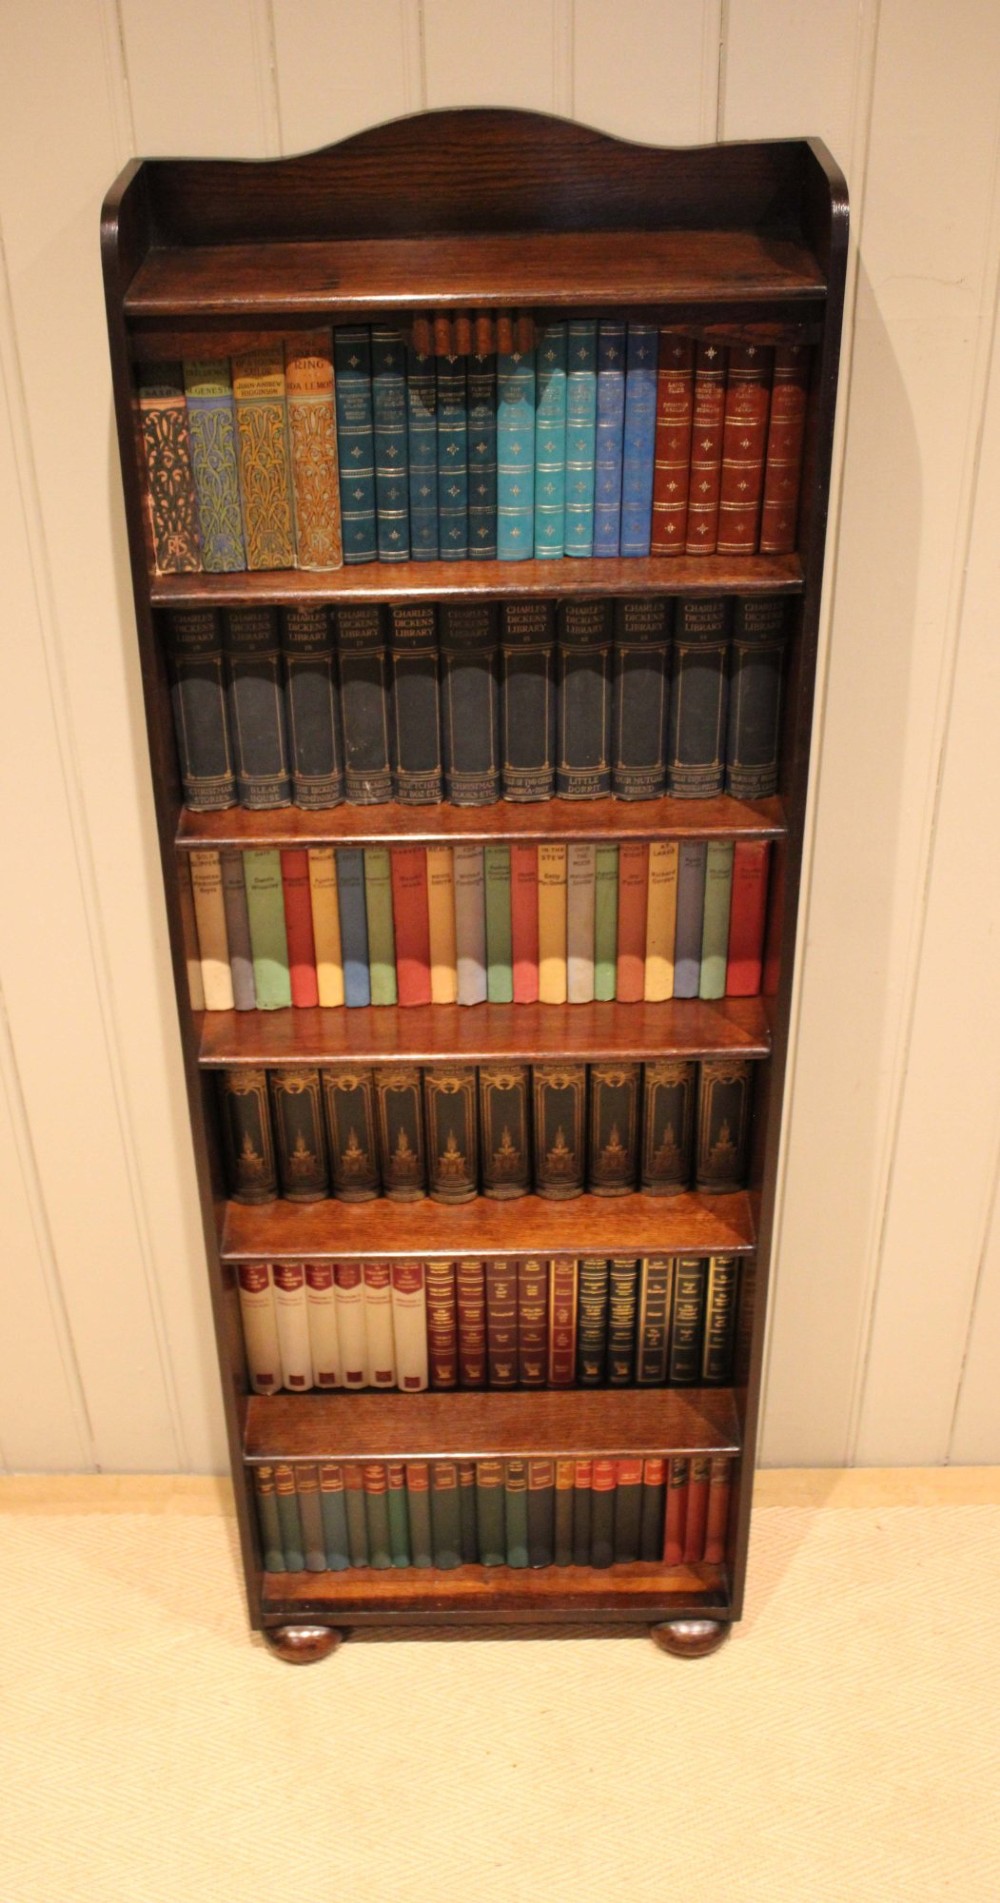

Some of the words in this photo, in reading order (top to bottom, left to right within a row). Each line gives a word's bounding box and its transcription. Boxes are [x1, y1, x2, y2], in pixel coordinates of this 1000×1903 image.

[295, 359, 324, 370] RING
[506, 605, 547, 615] CHARLES
[565, 605, 605, 614] CHARLES
[624, 603, 665, 612] CHARLES
[684, 603, 724, 612] CHARLES
[287, 613, 327, 622] CHARLES
[338, 610, 379, 619] CHARLES
[393, 608, 434, 618] CHARLES
[625, 612, 665, 622] DICKENS
[684, 612, 724, 622] DICKENS
[339, 619, 380, 628] DICKENS
[394, 618, 434, 627] DICKENS
[507, 614, 547, 624] DICKENS
[566, 614, 605, 624] DICKENS
[288, 622, 328, 632] DICKENS
[395, 627, 434, 637] LIBRARY
[507, 623, 546, 633] LIBRARY
[566, 624, 604, 634] LIBRARY
[625, 622, 663, 632] LIBRARY
[684, 622, 722, 632] LIBRARY
[288, 631, 327, 641] LIBRARY
[340, 628, 378, 638] LIBRARY
[451, 780, 495, 790] CHRISTMAS
[568, 776, 599, 785] LITTLE
[249, 785, 280, 794] BLEAK
[567, 784, 601, 793] DORRIT
[249, 794, 280, 803] HOUSE
